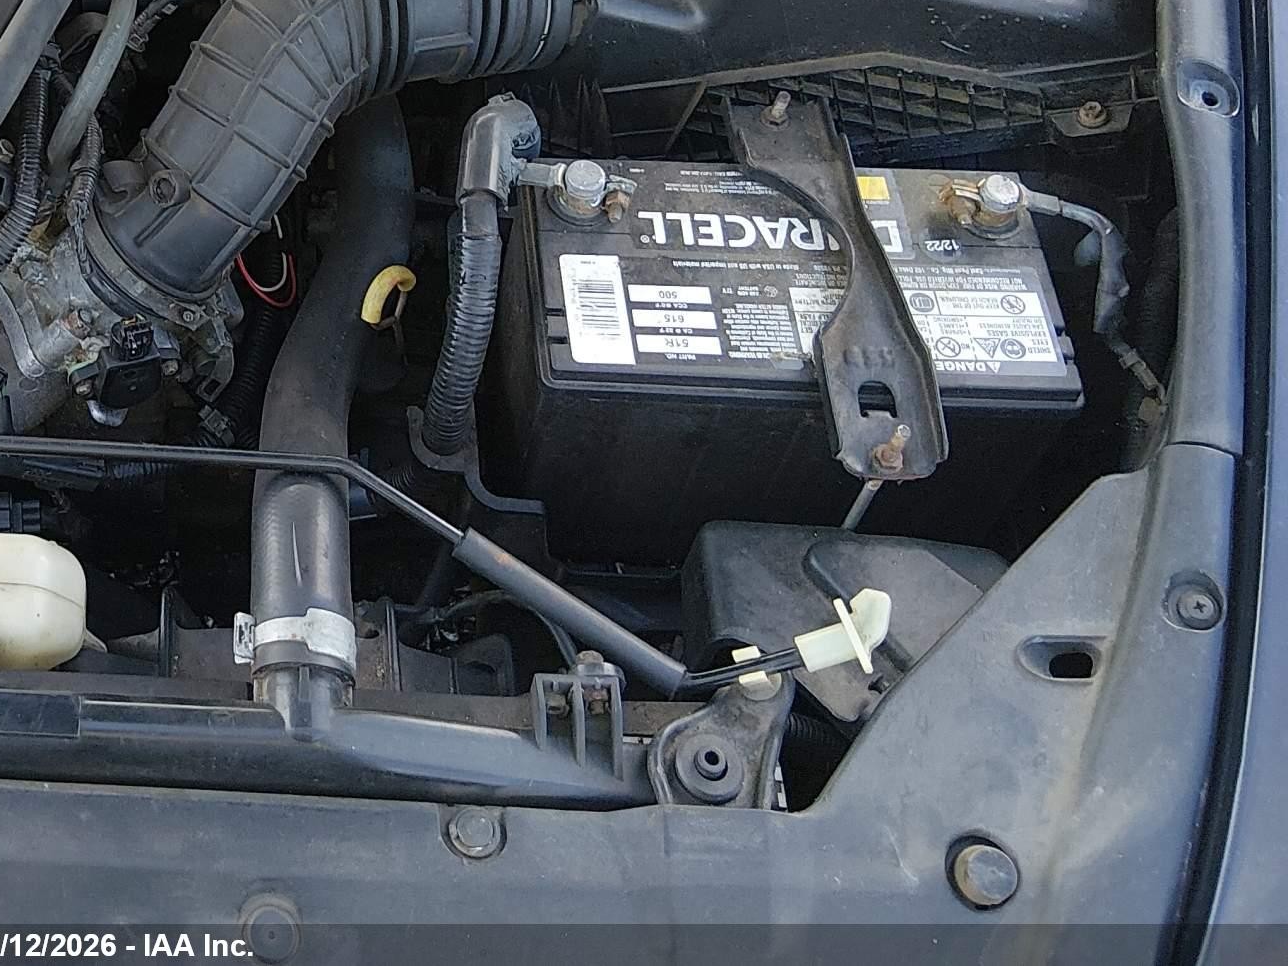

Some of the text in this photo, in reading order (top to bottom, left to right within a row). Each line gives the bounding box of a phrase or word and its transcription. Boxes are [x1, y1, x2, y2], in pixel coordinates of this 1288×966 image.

[637, 211, 904, 253] DRACELL
[924, 238, 960, 251] 12/22
[658, 290, 678, 299] 500
[663, 314, 684, 324] 615
[664, 338, 688, 348] 51R
[934, 360, 986, 371] DANGE
